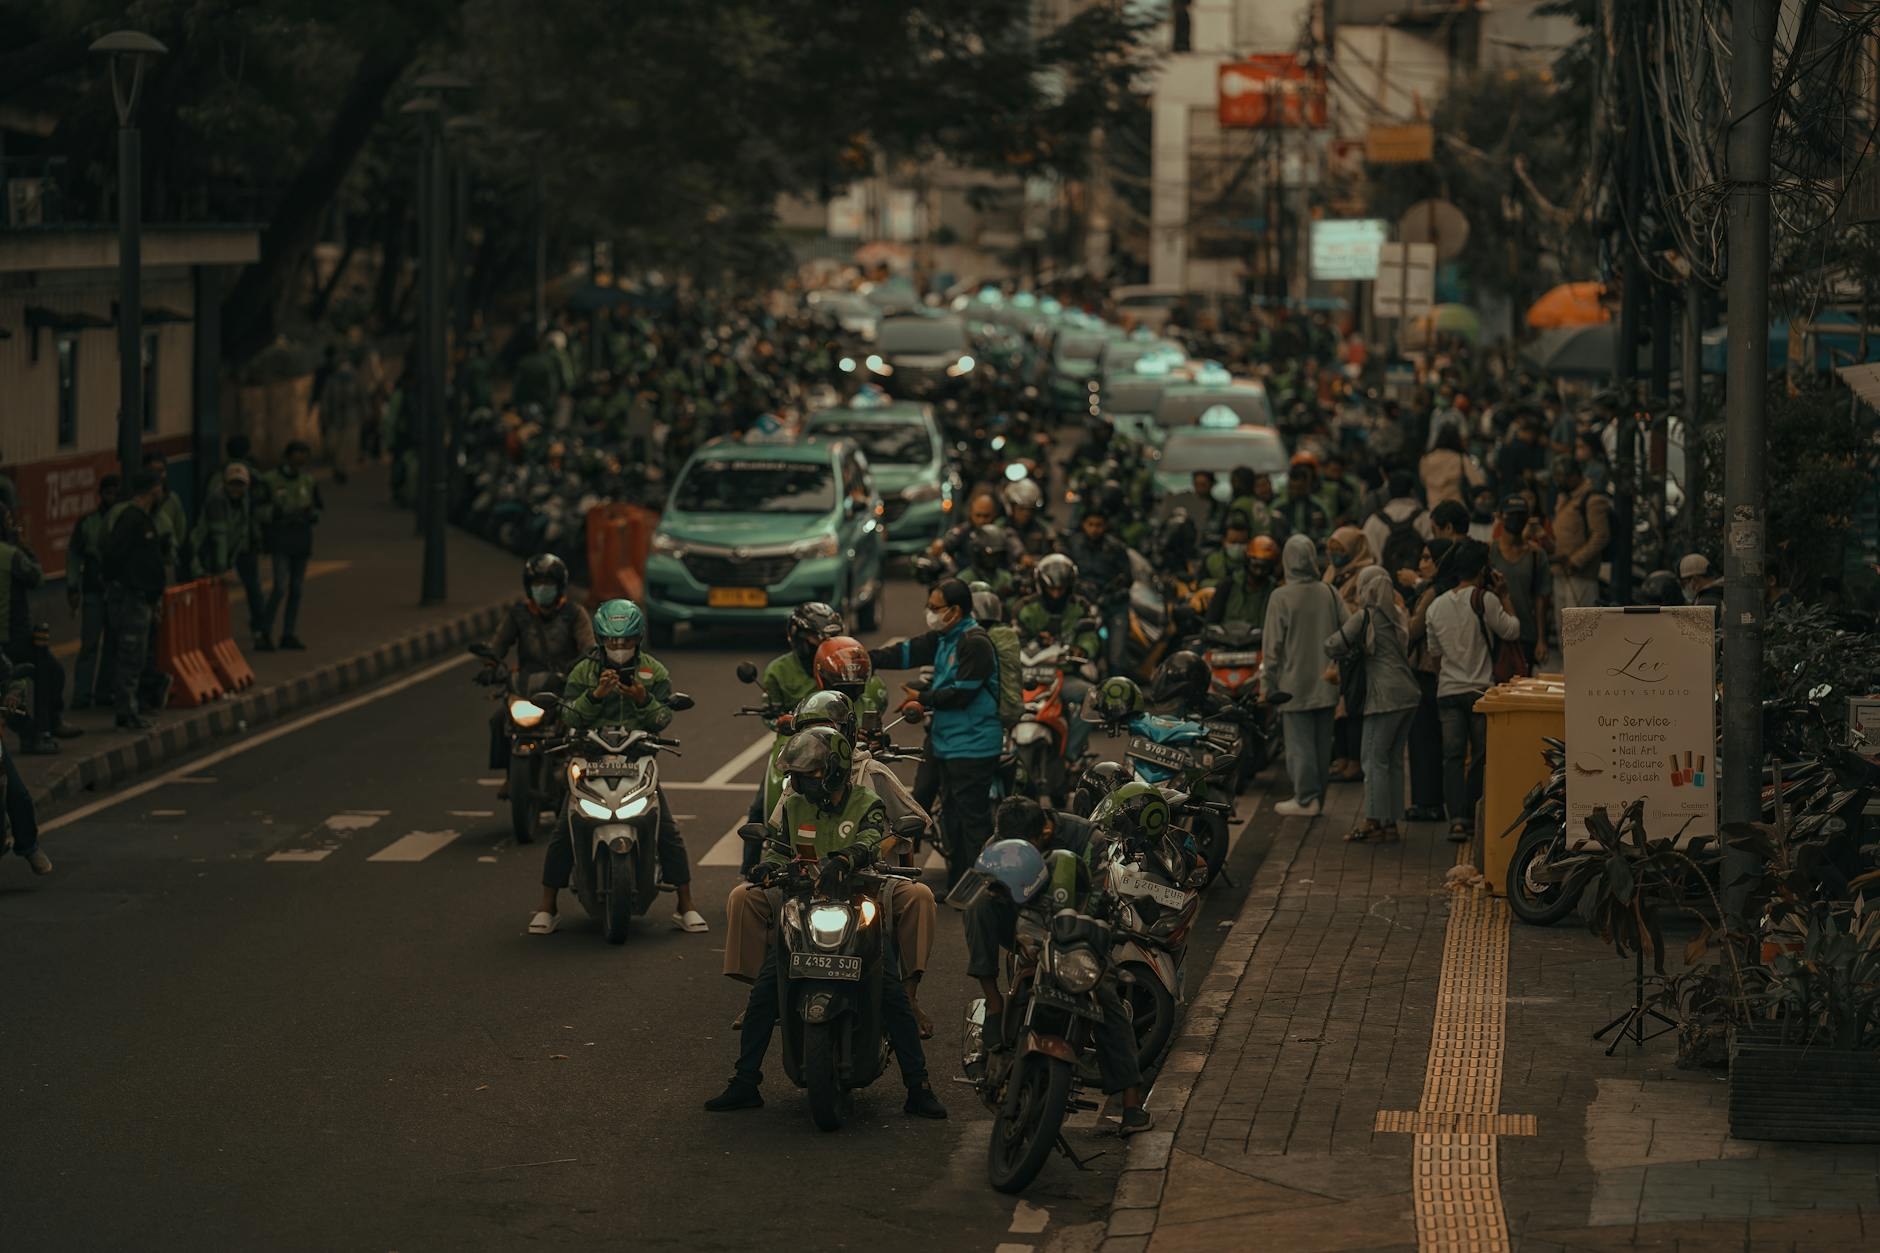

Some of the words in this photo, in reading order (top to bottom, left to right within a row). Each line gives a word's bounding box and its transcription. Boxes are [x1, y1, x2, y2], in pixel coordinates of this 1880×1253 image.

[1588, 688, 1635, 697] BEAUTY
[1643, 688, 1690, 696] STUDIO
[1597, 715, 1620, 727] Our
[1623, 714, 1671, 727] Service
[1618, 732, 1667, 742] Manicure
[1618, 745, 1636, 756] Nail
[1640, 745, 1658, 756] Art
[1618, 758, 1665, 769] Pedicure
[1619, 771, 1660, 784] Eyelash
[793, 955, 800, 966] B
